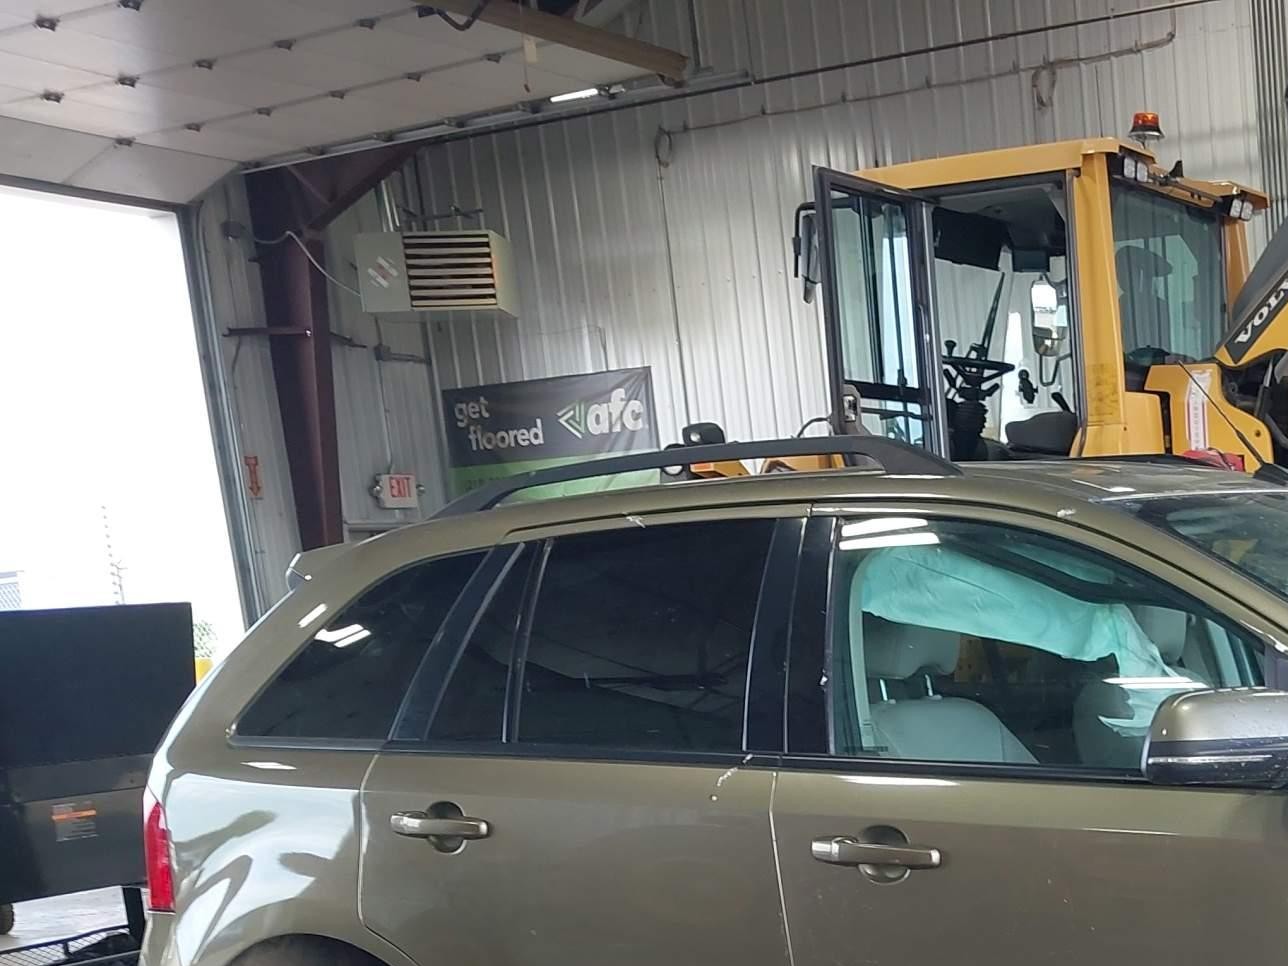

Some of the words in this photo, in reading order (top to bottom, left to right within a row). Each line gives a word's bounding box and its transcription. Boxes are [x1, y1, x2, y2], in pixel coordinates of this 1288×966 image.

[454, 396, 491, 428] get
[586, 388, 645, 436] afc
[468, 418, 545, 451] floored
[388, 476, 412, 498] EXIT
